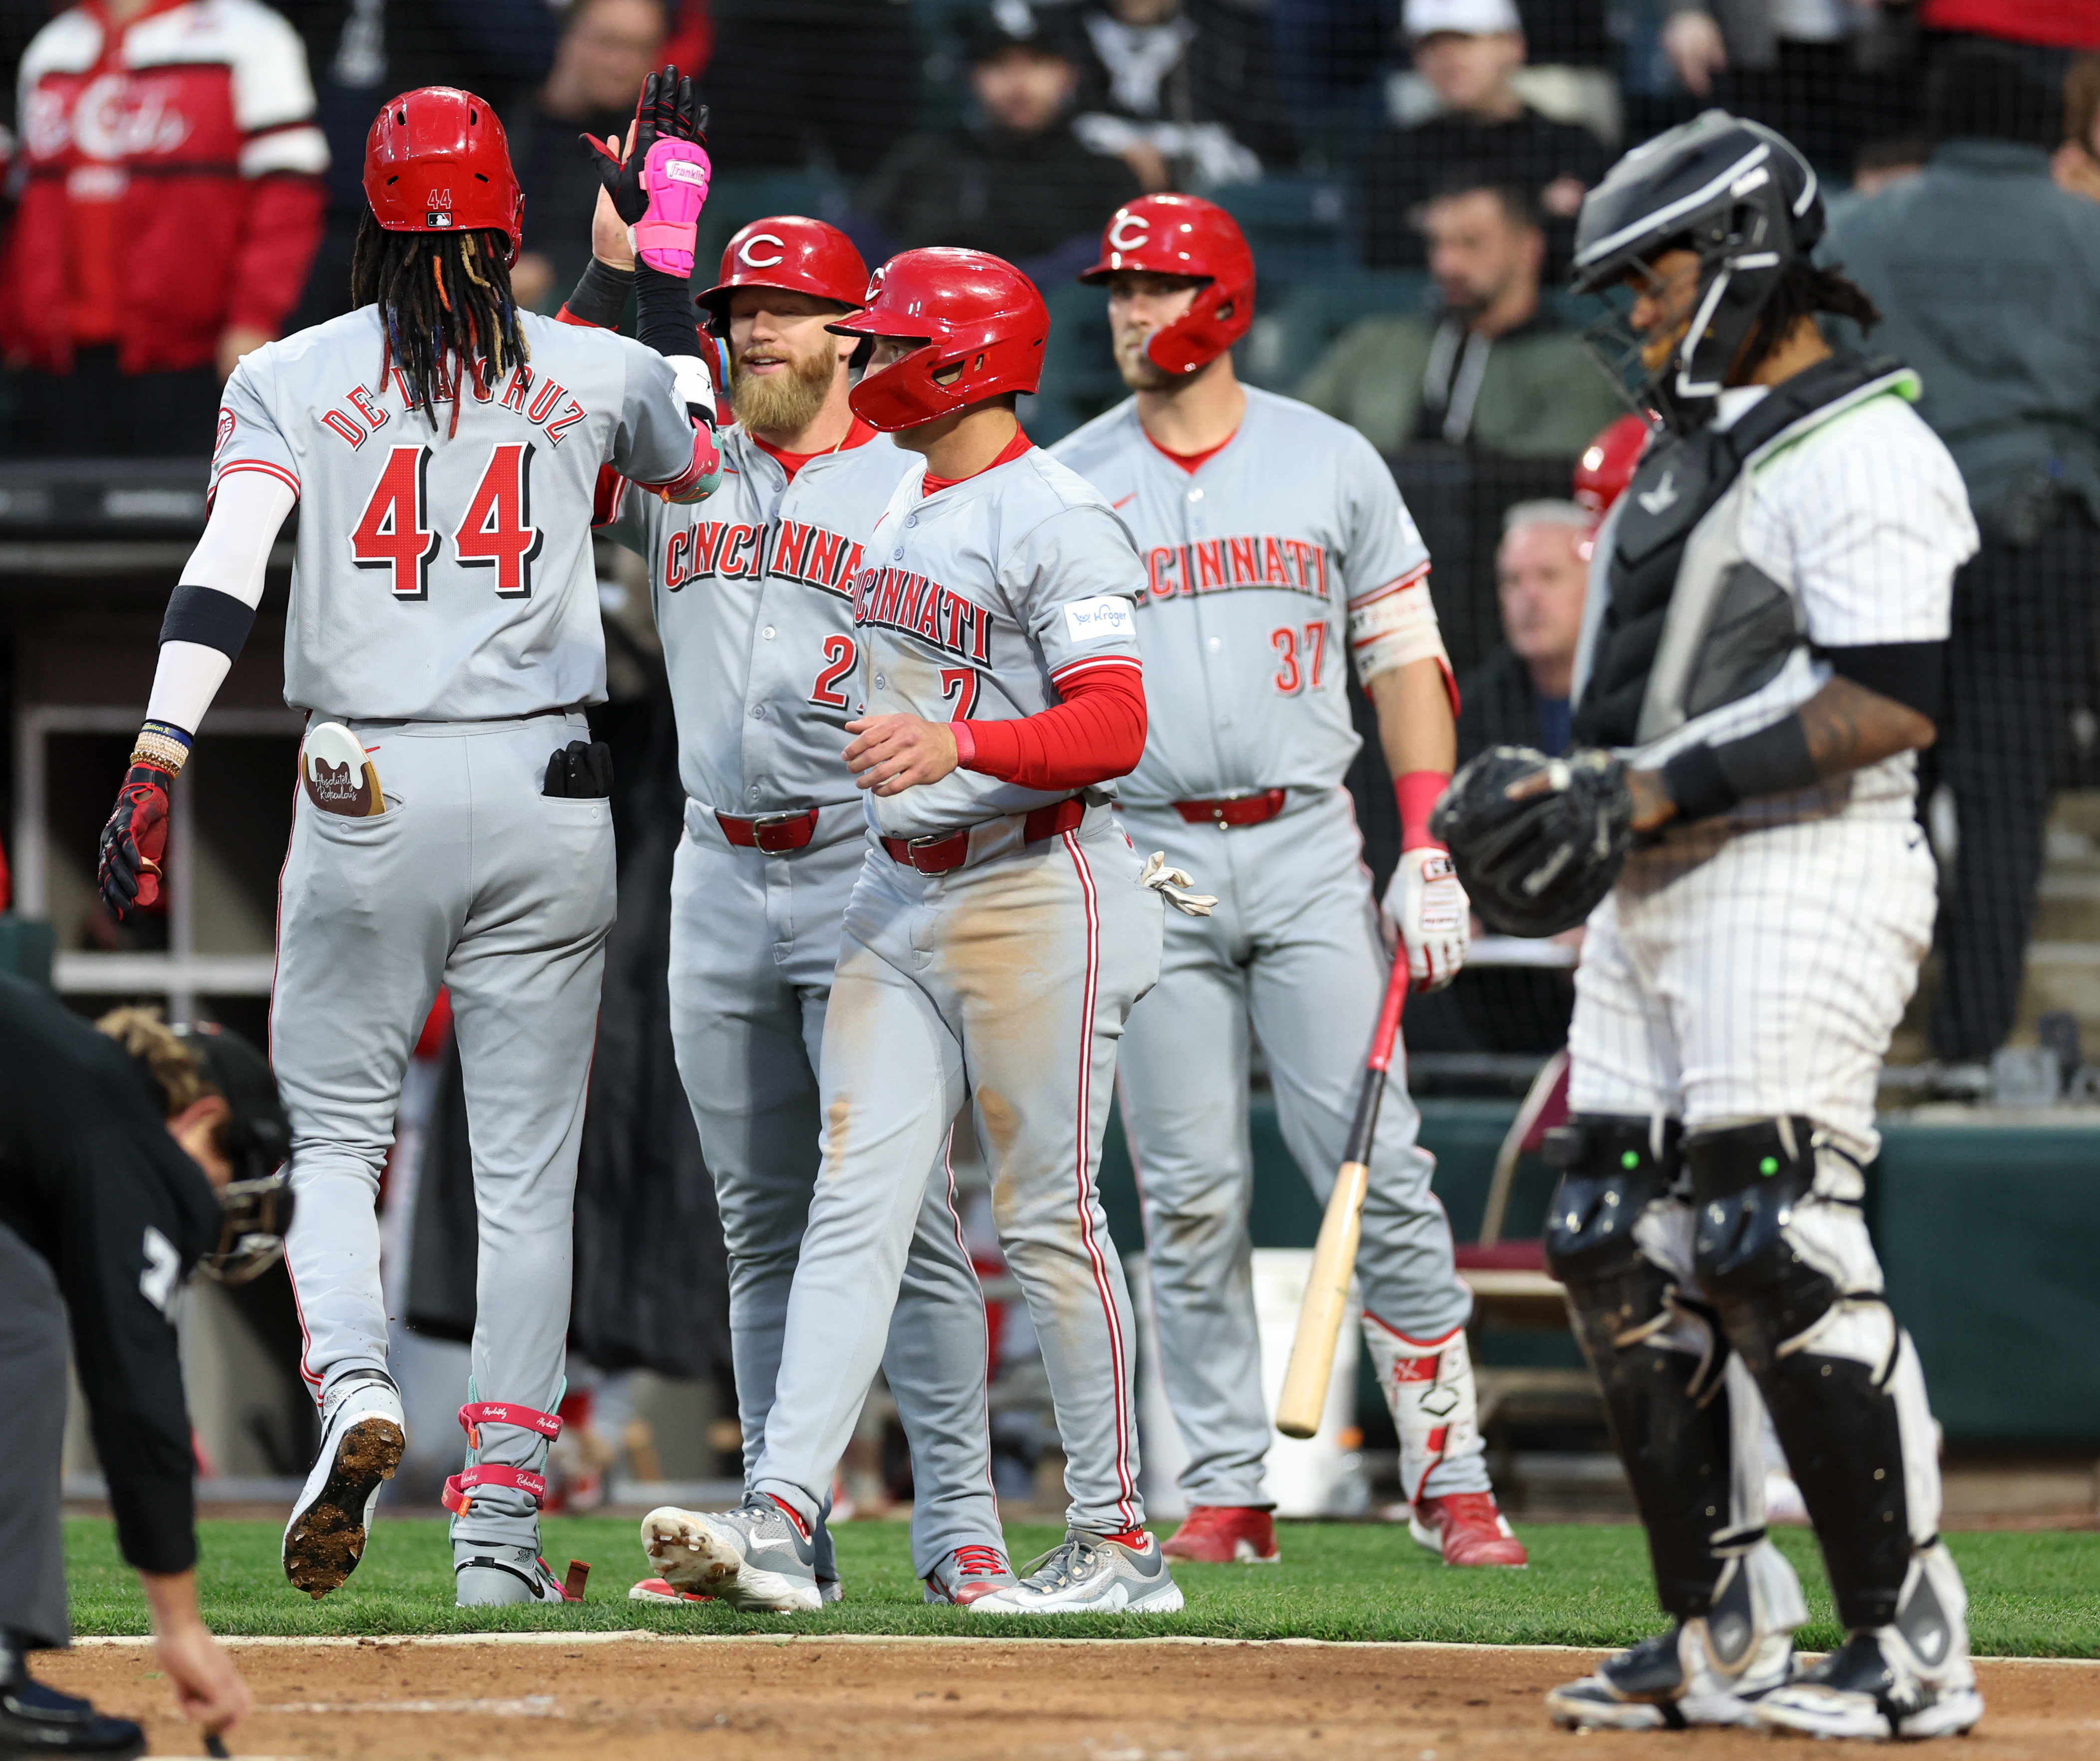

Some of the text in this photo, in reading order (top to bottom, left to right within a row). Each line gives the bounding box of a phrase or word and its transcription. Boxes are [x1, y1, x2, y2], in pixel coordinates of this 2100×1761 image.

[669, 162, 704, 182] Franklin
[427, 189, 452, 210] 44
[1108, 215, 1151, 251] C
[738, 234, 785, 267] C
[318, 383, 391, 452] DE
[471, 355, 588, 448] CRUZ
[347, 441, 544, 601] 44
[1137, 532, 1331, 603] CINNATI
[1094, 604, 1126, 627] Kroger
[1270, 619, 1330, 696] 37
[937, 667, 980, 723] 7
[315, 771, 354, 791] Absolutely
[317, 786, 357, 801] Ridiculous
[482, 1406, 507, 1419] Absolutely
